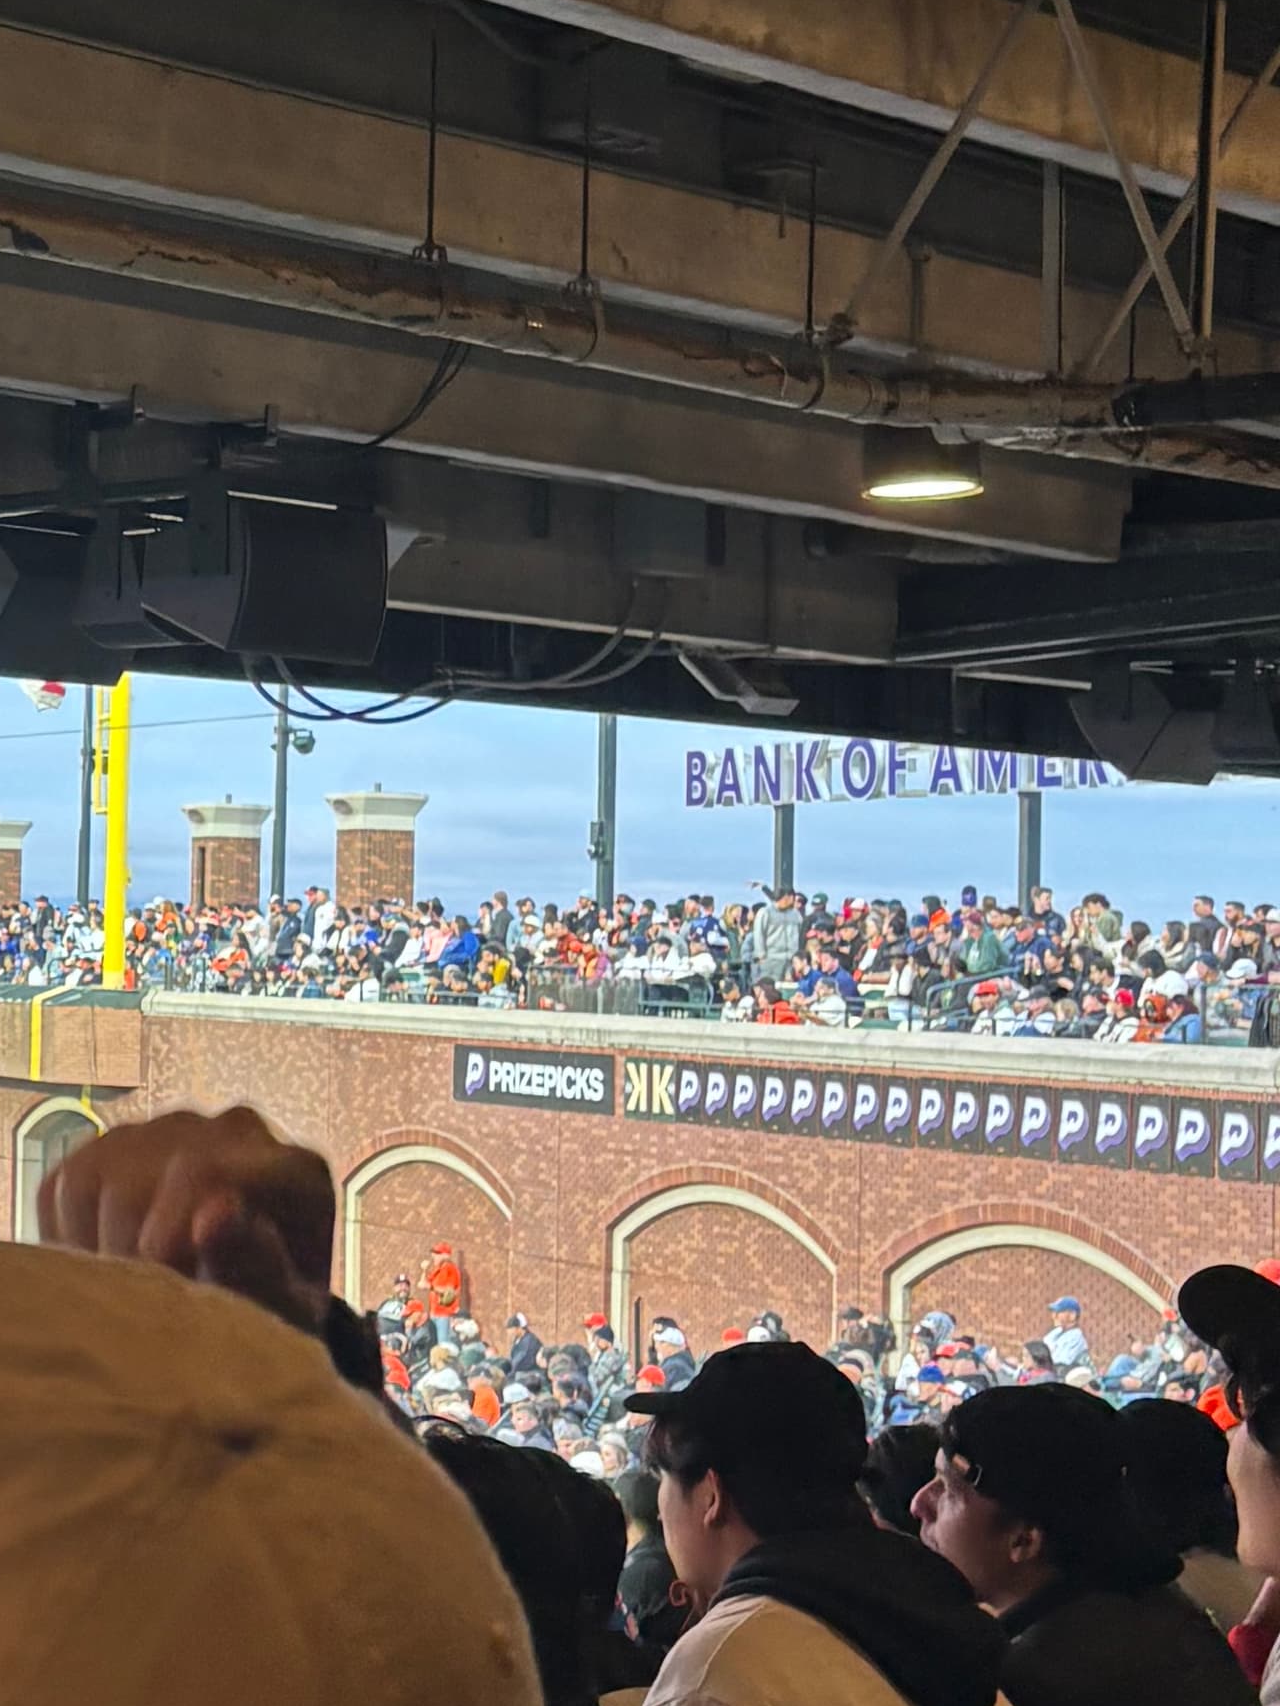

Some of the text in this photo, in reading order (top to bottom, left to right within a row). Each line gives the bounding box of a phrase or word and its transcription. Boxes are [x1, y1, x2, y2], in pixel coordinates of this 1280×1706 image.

[685, 738, 909, 807] BANK OF
[488, 1060, 605, 1103] PRIZEPICKS
